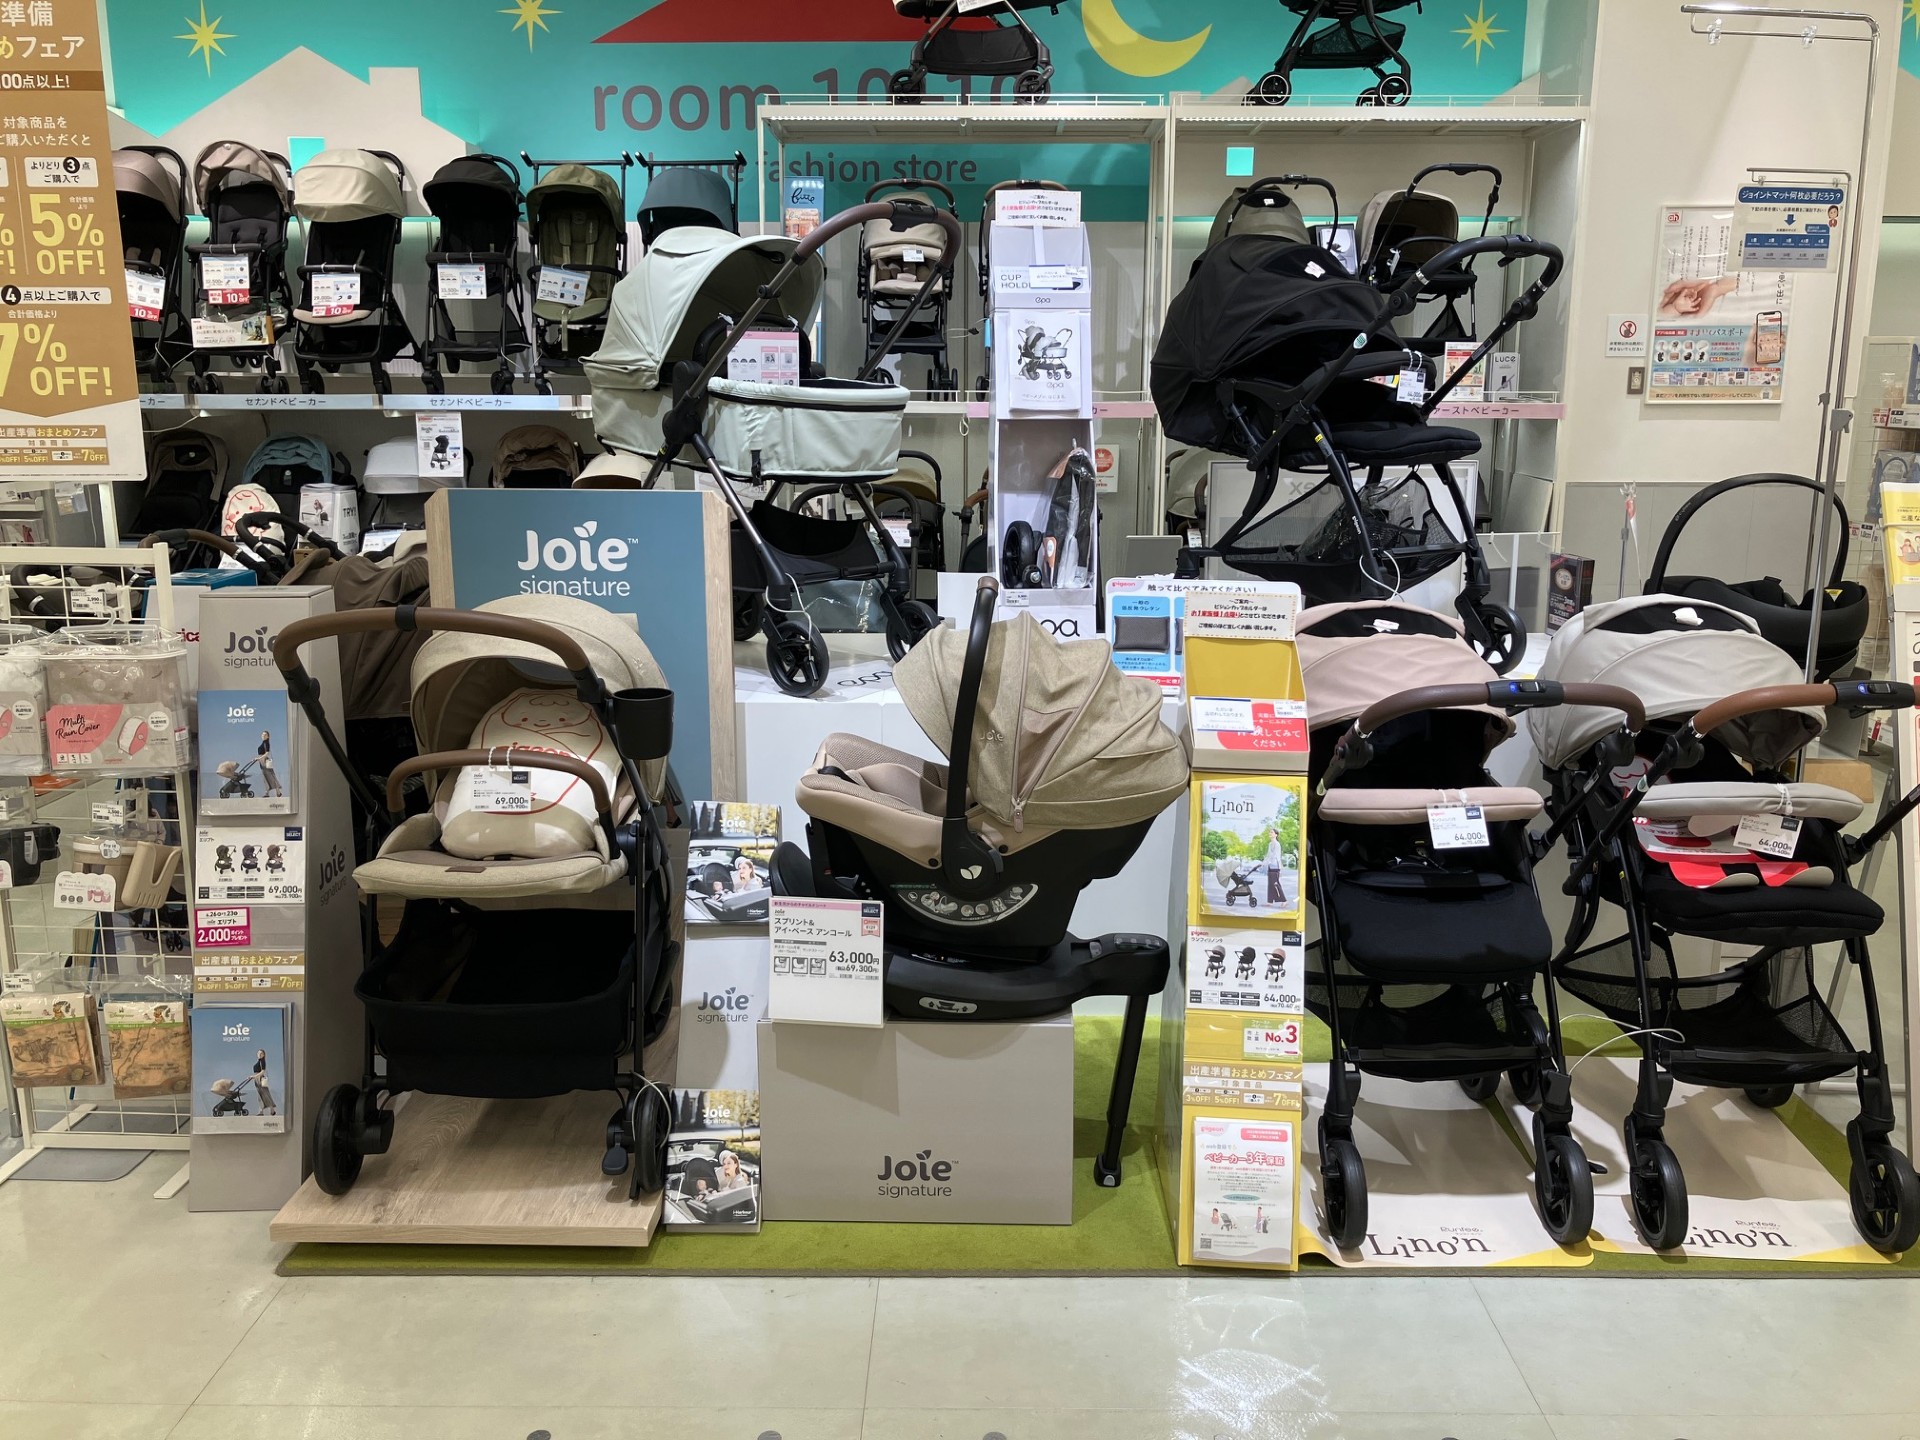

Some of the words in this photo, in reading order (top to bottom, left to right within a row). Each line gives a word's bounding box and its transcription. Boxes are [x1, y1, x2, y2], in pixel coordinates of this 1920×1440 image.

[1, 1, 54, 28] 準備
[594, 83, 780, 132] room
[3, 115, 68, 130] 対象商品を
[893, 157, 977, 183] store
[43, 174, 80, 184] ご購入で
[29, 193, 105, 247] 5%
[36, 249, 106, 275] OFF!
[1001, 281, 1030, 289] HOLD
[8, 309, 58, 319] 合計価格より
[29, 366, 113, 397] OFF!
[517, 521, 630, 573] Joie
[519, 574, 631, 596] signature
[223, 656, 277, 669] signatur
[226, 704, 255, 717] Joie
[55, 728, 78, 740] Rain
[76, 723, 100, 736] Cover
[1252, 739, 1287, 748] ください
[198, 928, 231, 943] 2,000
[816, 928, 852, 937] アンコール
[829, 950, 880, 966] 63,000円
[697, 986, 750, 1011] Joie
[697, 1012, 749, 1025] signature
[222, 1023, 251, 1036] Joie
[703, 1105, 731, 1118] Joie
[877, 1149, 952, 1182] Joie
[1204, 1151, 1286, 1166] ベビーカー3年保証
[877, 1183, 952, 1199] signature
[1366, 1233, 1491, 1259] Lino'n
